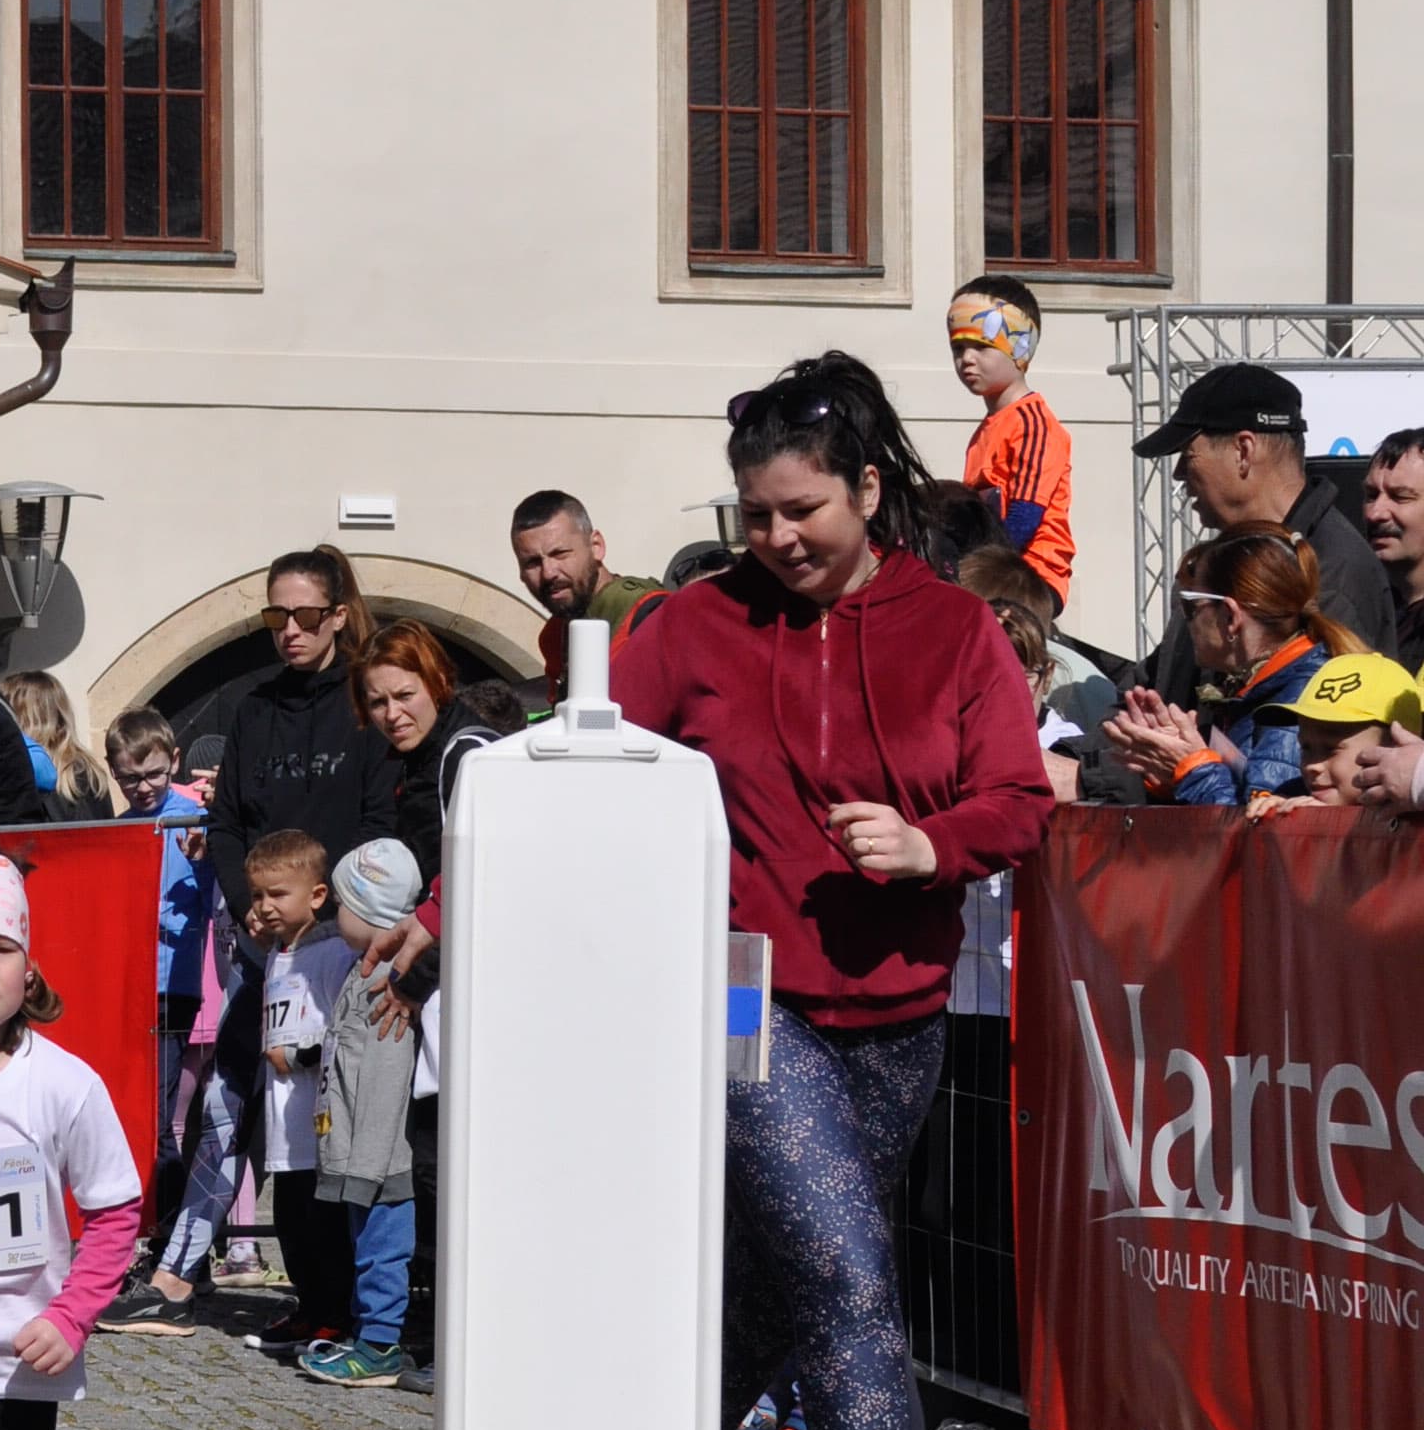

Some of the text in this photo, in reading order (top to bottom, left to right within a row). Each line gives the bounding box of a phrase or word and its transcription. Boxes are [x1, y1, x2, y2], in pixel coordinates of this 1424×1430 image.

[18, 1165, 35, 1175] run
[1139, 1246, 1231, 1295] QUALITY
[1339, 1274, 1419, 1331] SPRING
